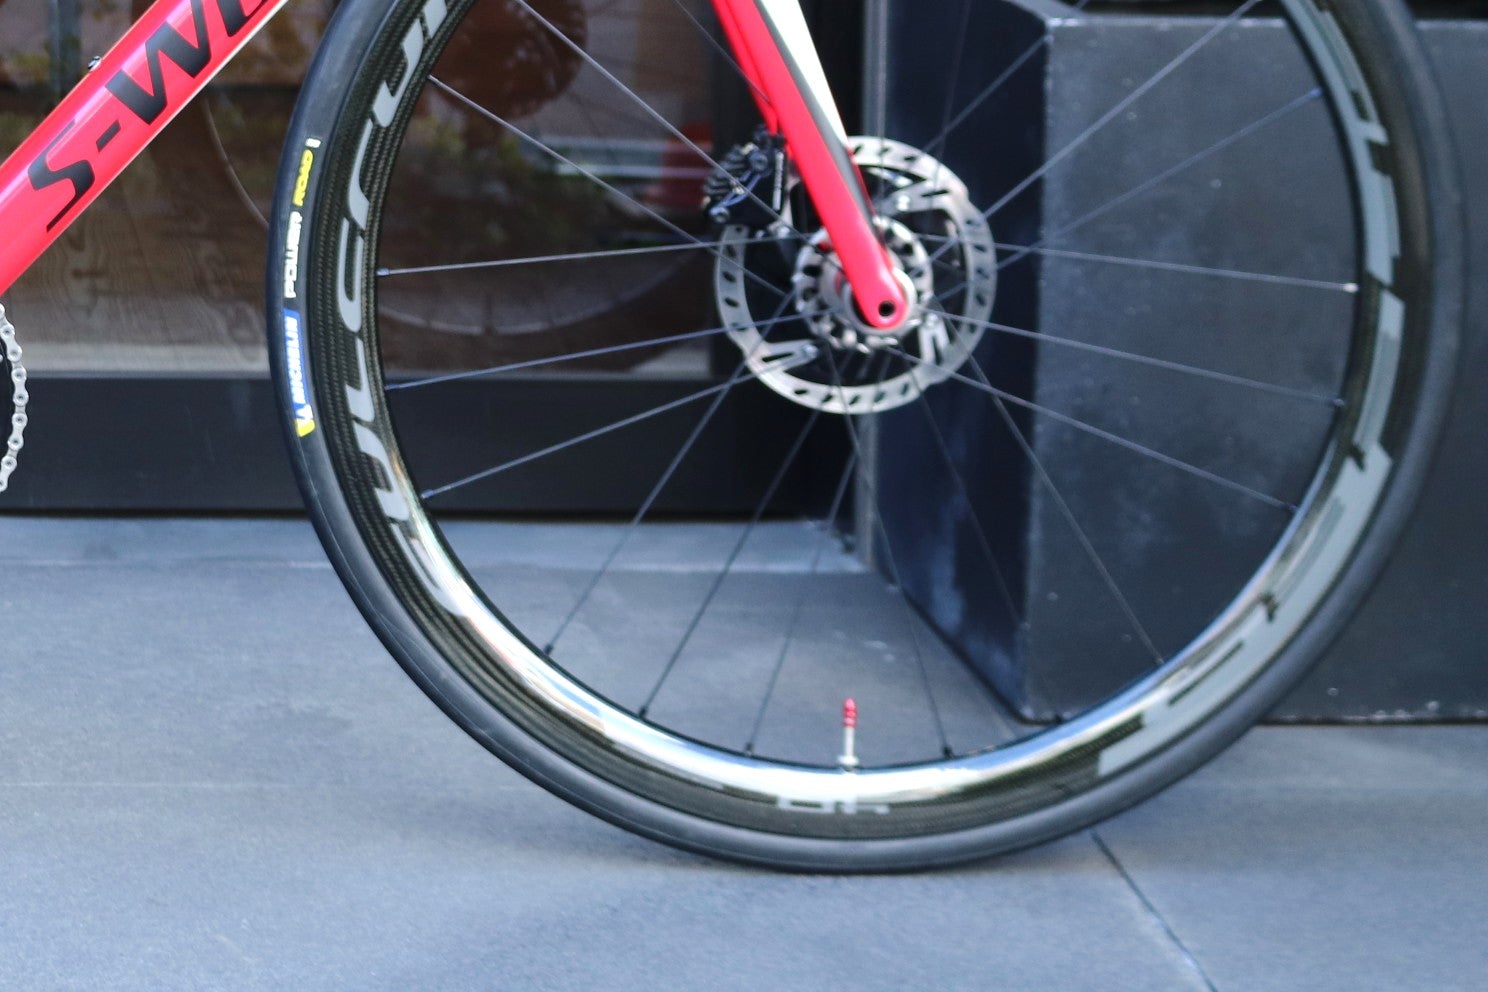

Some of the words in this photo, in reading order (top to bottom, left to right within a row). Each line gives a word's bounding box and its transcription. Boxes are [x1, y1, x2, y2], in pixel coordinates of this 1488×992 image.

[292, 149, 313, 206] ROAD
[284, 211, 303, 298] POWER
[284, 316, 308, 407] MICHELIN
